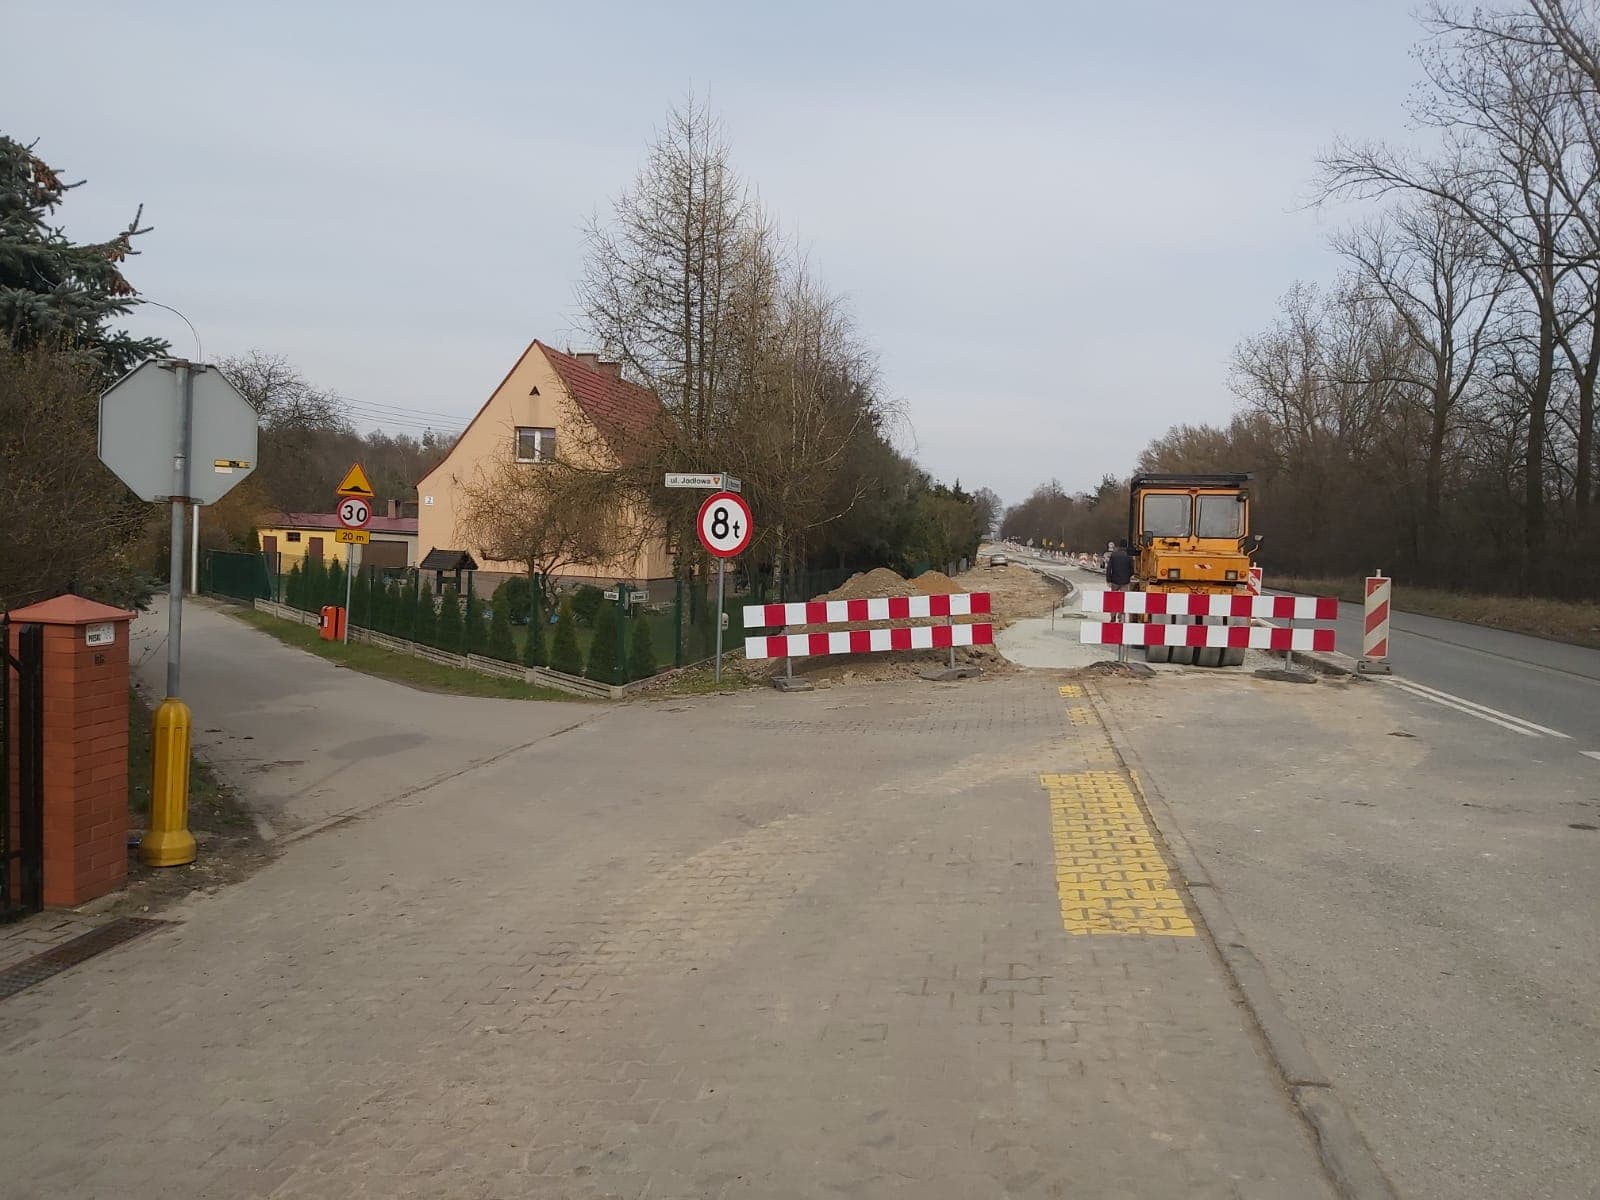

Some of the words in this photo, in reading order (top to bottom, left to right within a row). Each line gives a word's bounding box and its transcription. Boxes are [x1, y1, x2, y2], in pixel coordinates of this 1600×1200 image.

[342, 504, 367, 523] 30
[711, 506, 730, 540] 8
[732, 519, 741, 539] t
[342, 532, 354, 541] 20
[356, 534, 364, 542] m
